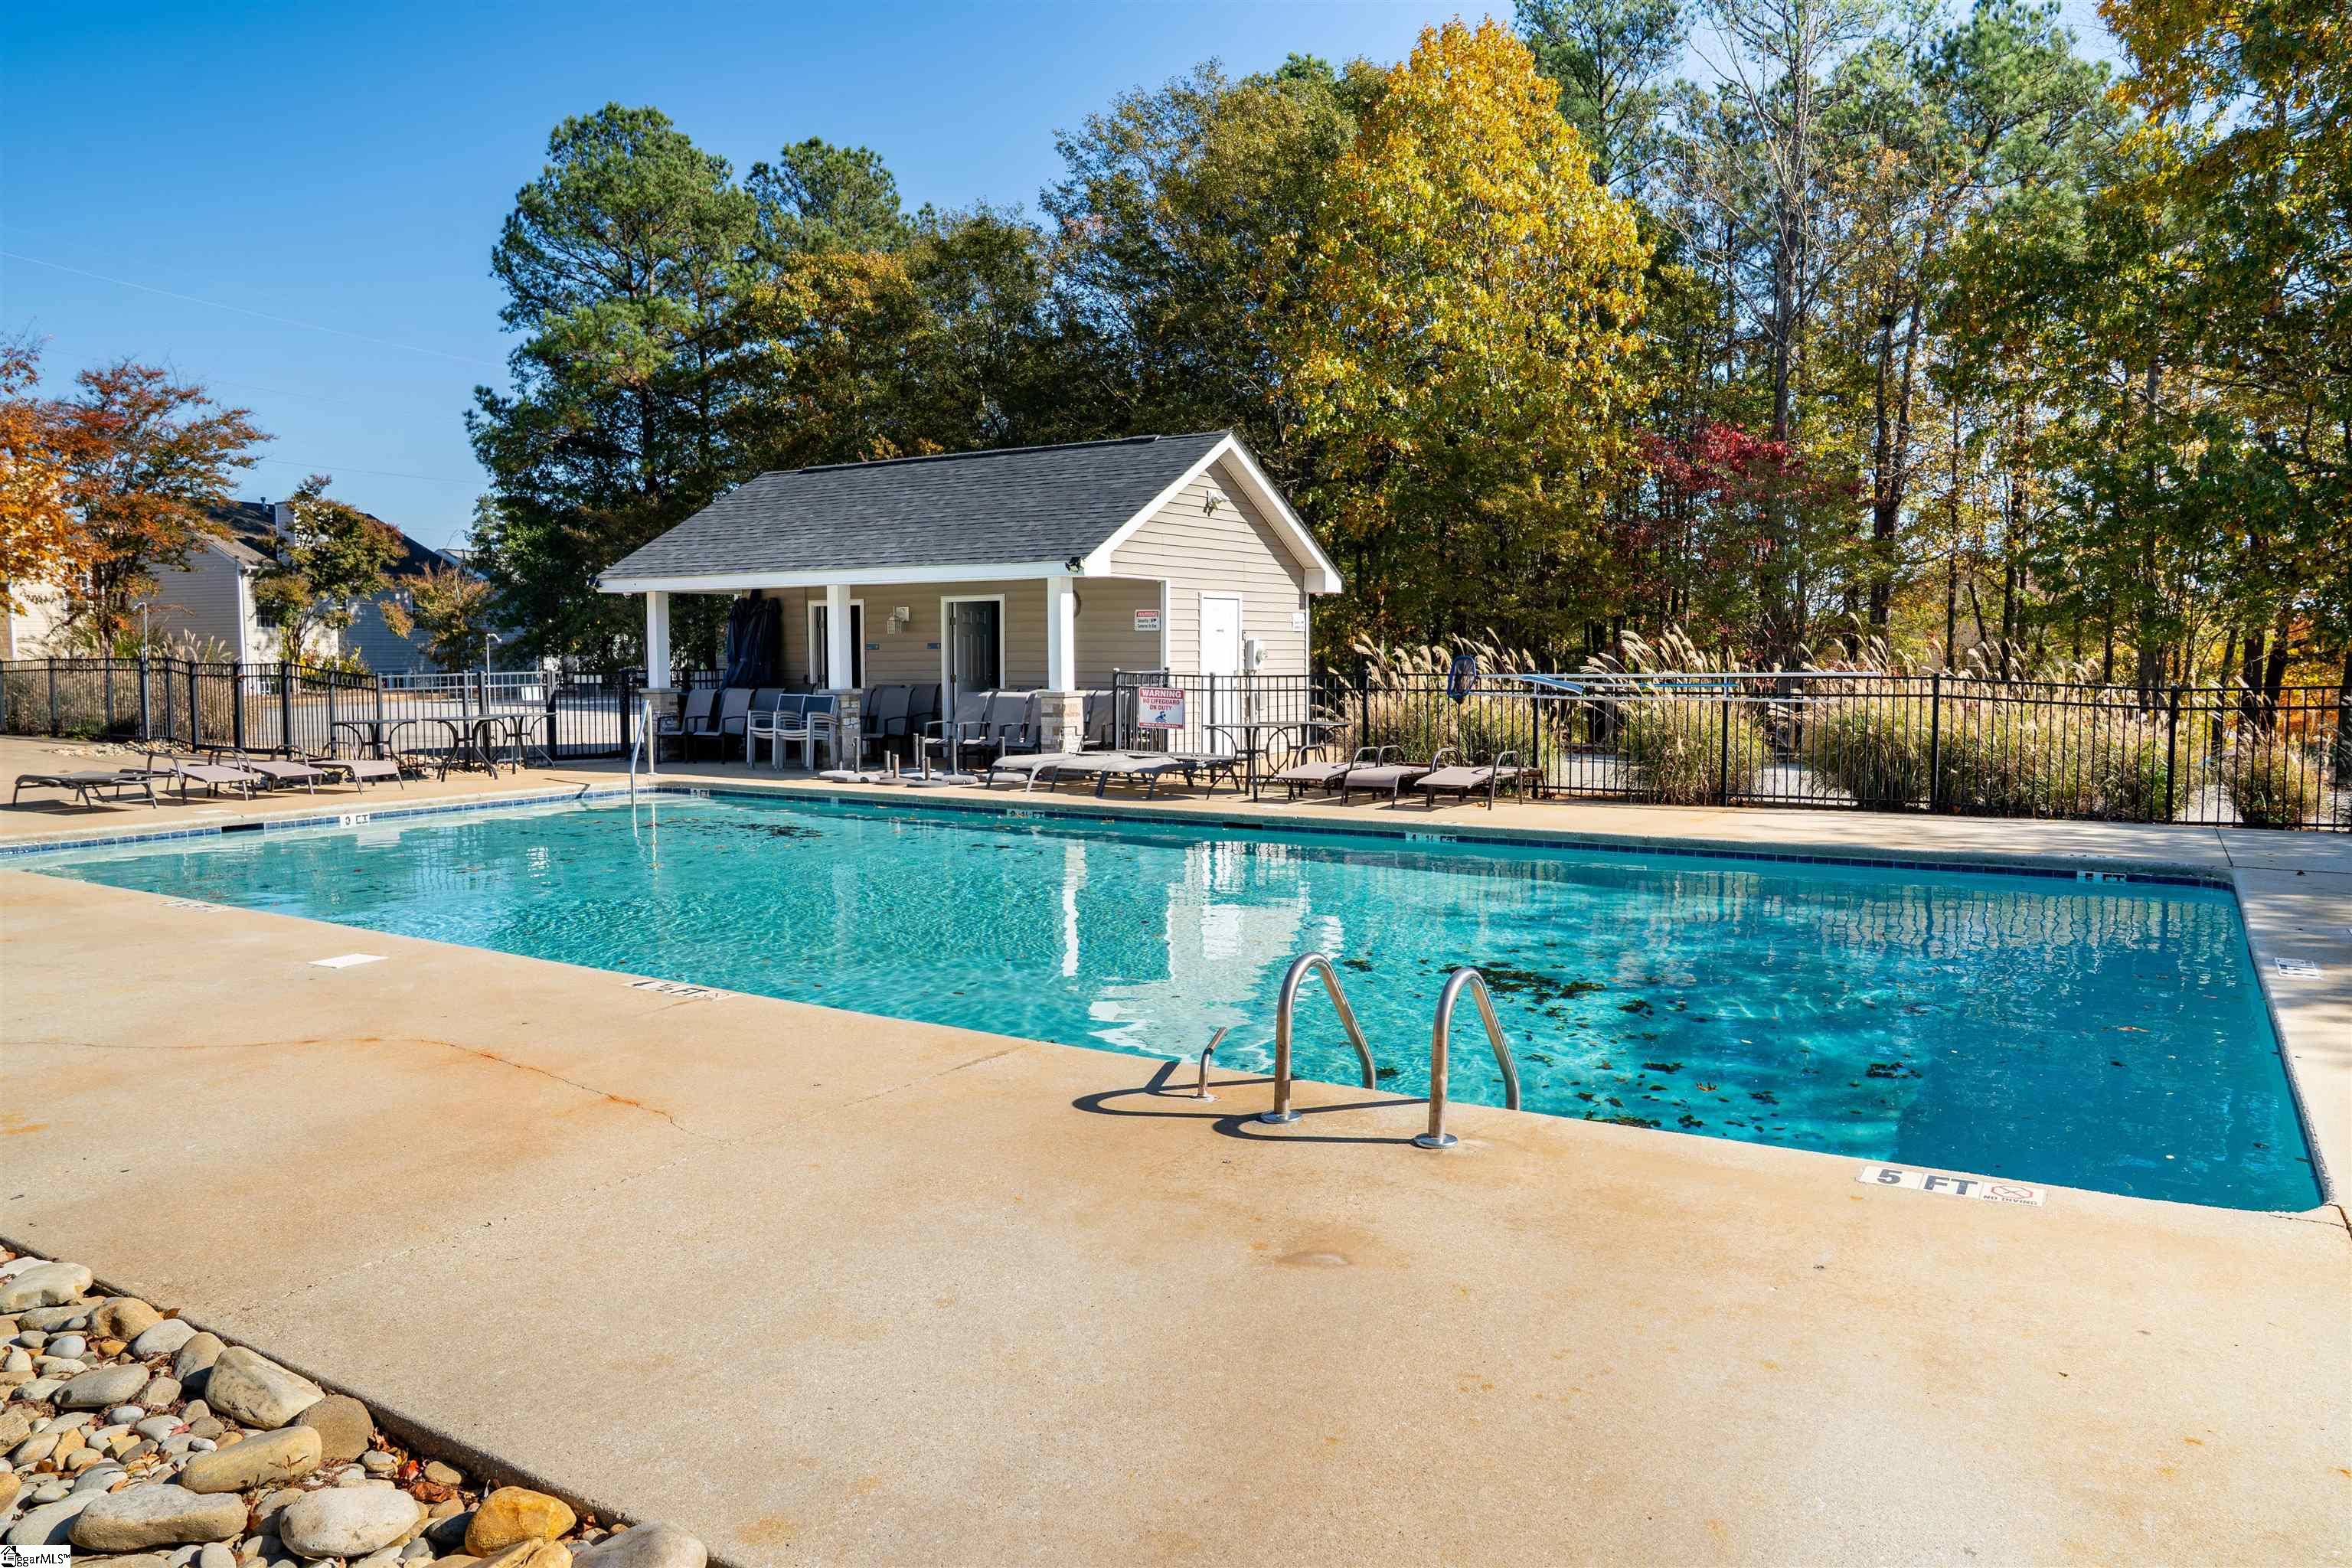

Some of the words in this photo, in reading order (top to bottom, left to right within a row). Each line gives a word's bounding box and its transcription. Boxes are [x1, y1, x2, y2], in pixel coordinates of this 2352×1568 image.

[1142, 689, 1182, 698] WARNING
[1877, 1168, 1903, 1185] 5
[1923, 1174, 1978, 1196] FT
[2001, 1197, 2038, 1206] DIVING
